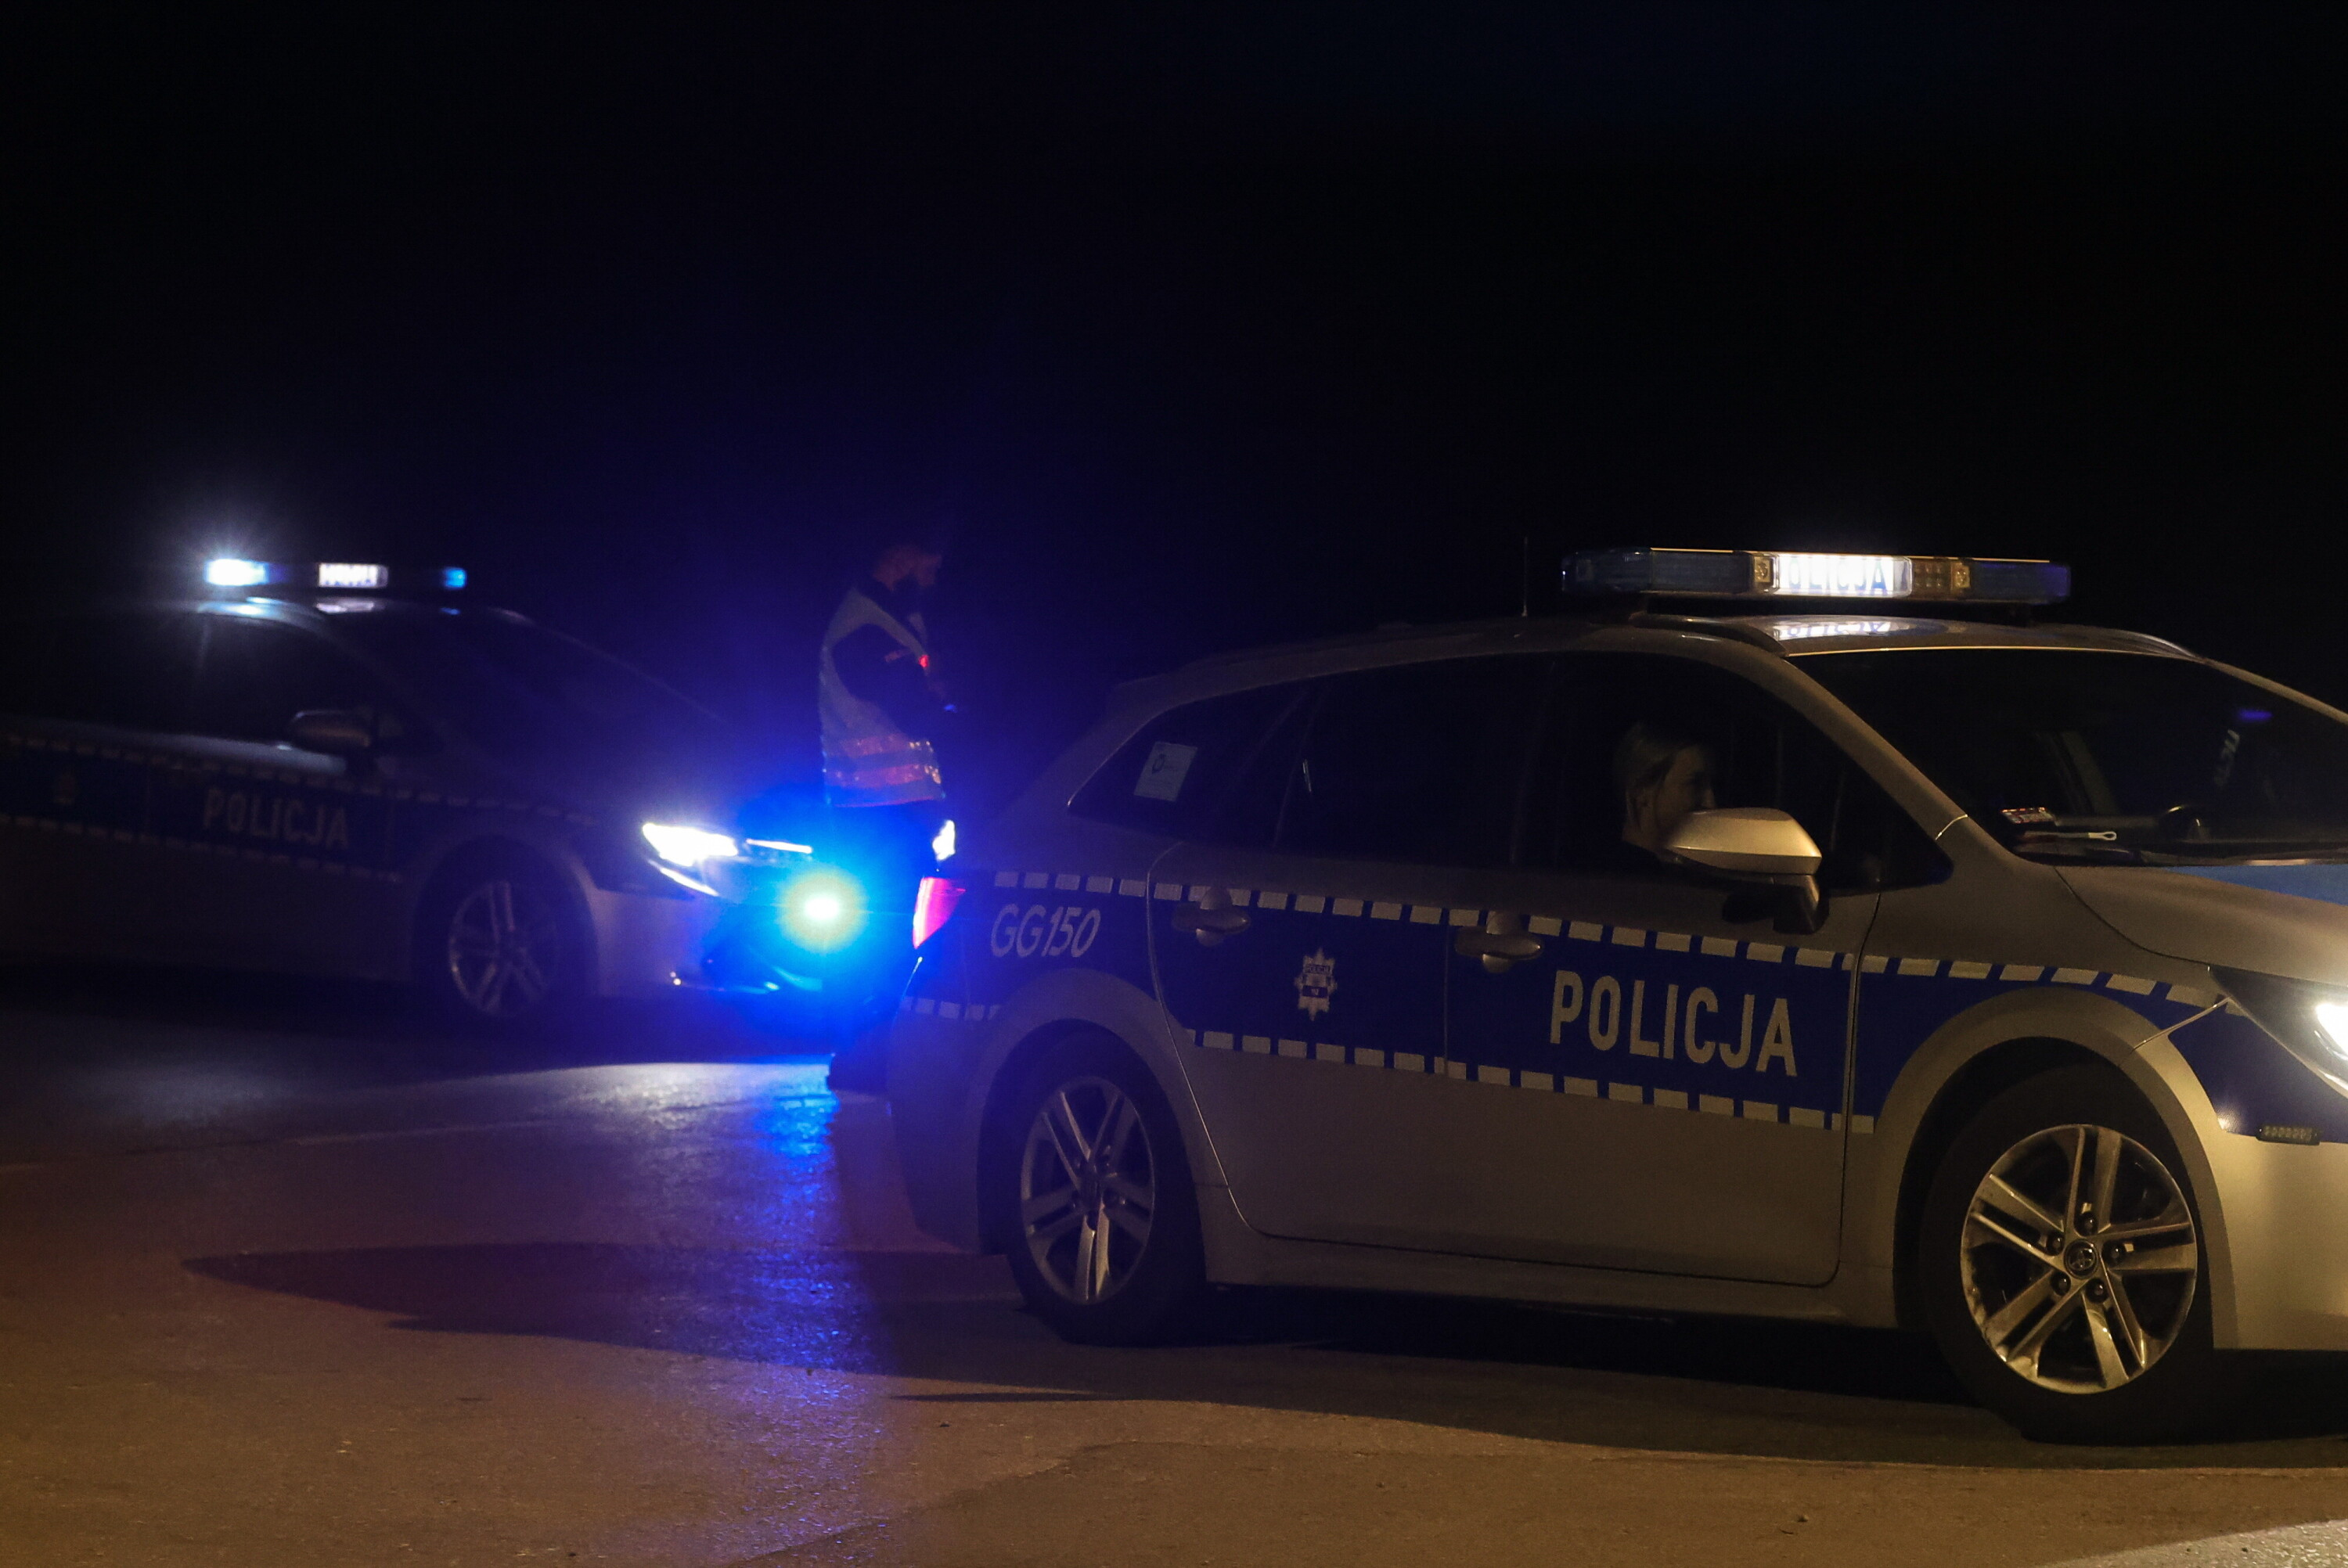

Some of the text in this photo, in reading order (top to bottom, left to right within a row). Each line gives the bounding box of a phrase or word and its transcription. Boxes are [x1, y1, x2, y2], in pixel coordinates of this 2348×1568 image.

[203, 786, 349, 851] POLICJA
[991, 903, 1101, 958] GG150
[1550, 969, 1798, 1077] POLICJA
